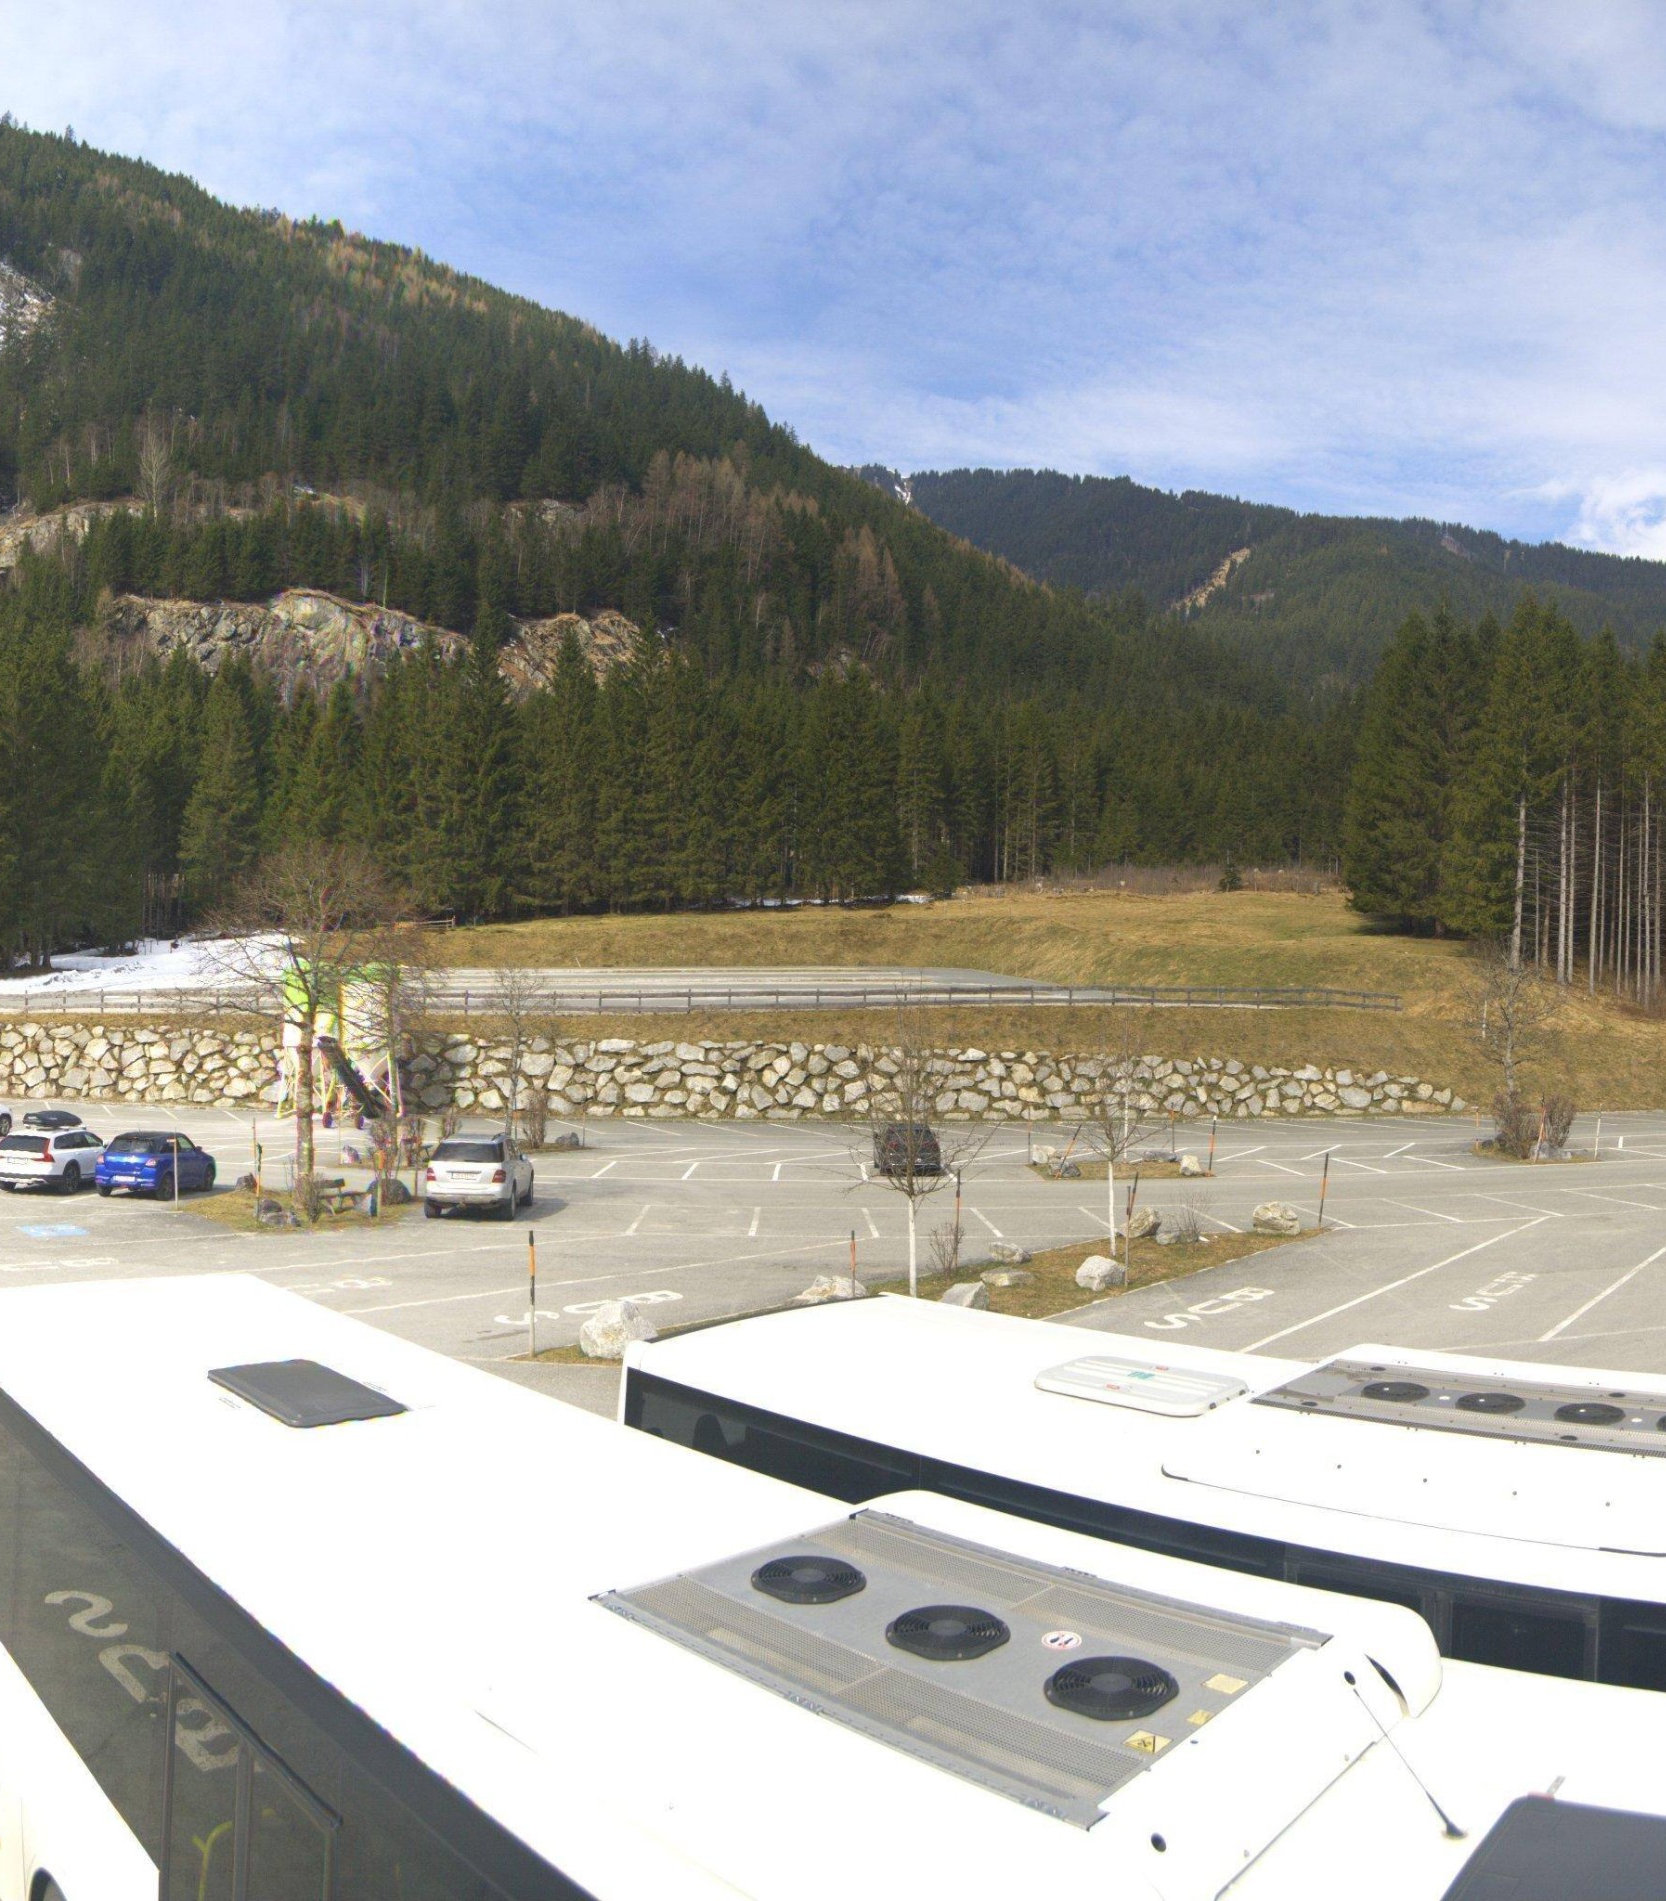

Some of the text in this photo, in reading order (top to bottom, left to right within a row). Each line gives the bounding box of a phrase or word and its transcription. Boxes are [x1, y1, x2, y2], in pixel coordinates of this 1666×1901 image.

[493, 1289, 684, 1326] BUS
[1144, 1286, 1276, 1330] BUS
[1448, 1271, 1539, 1311] BUS
